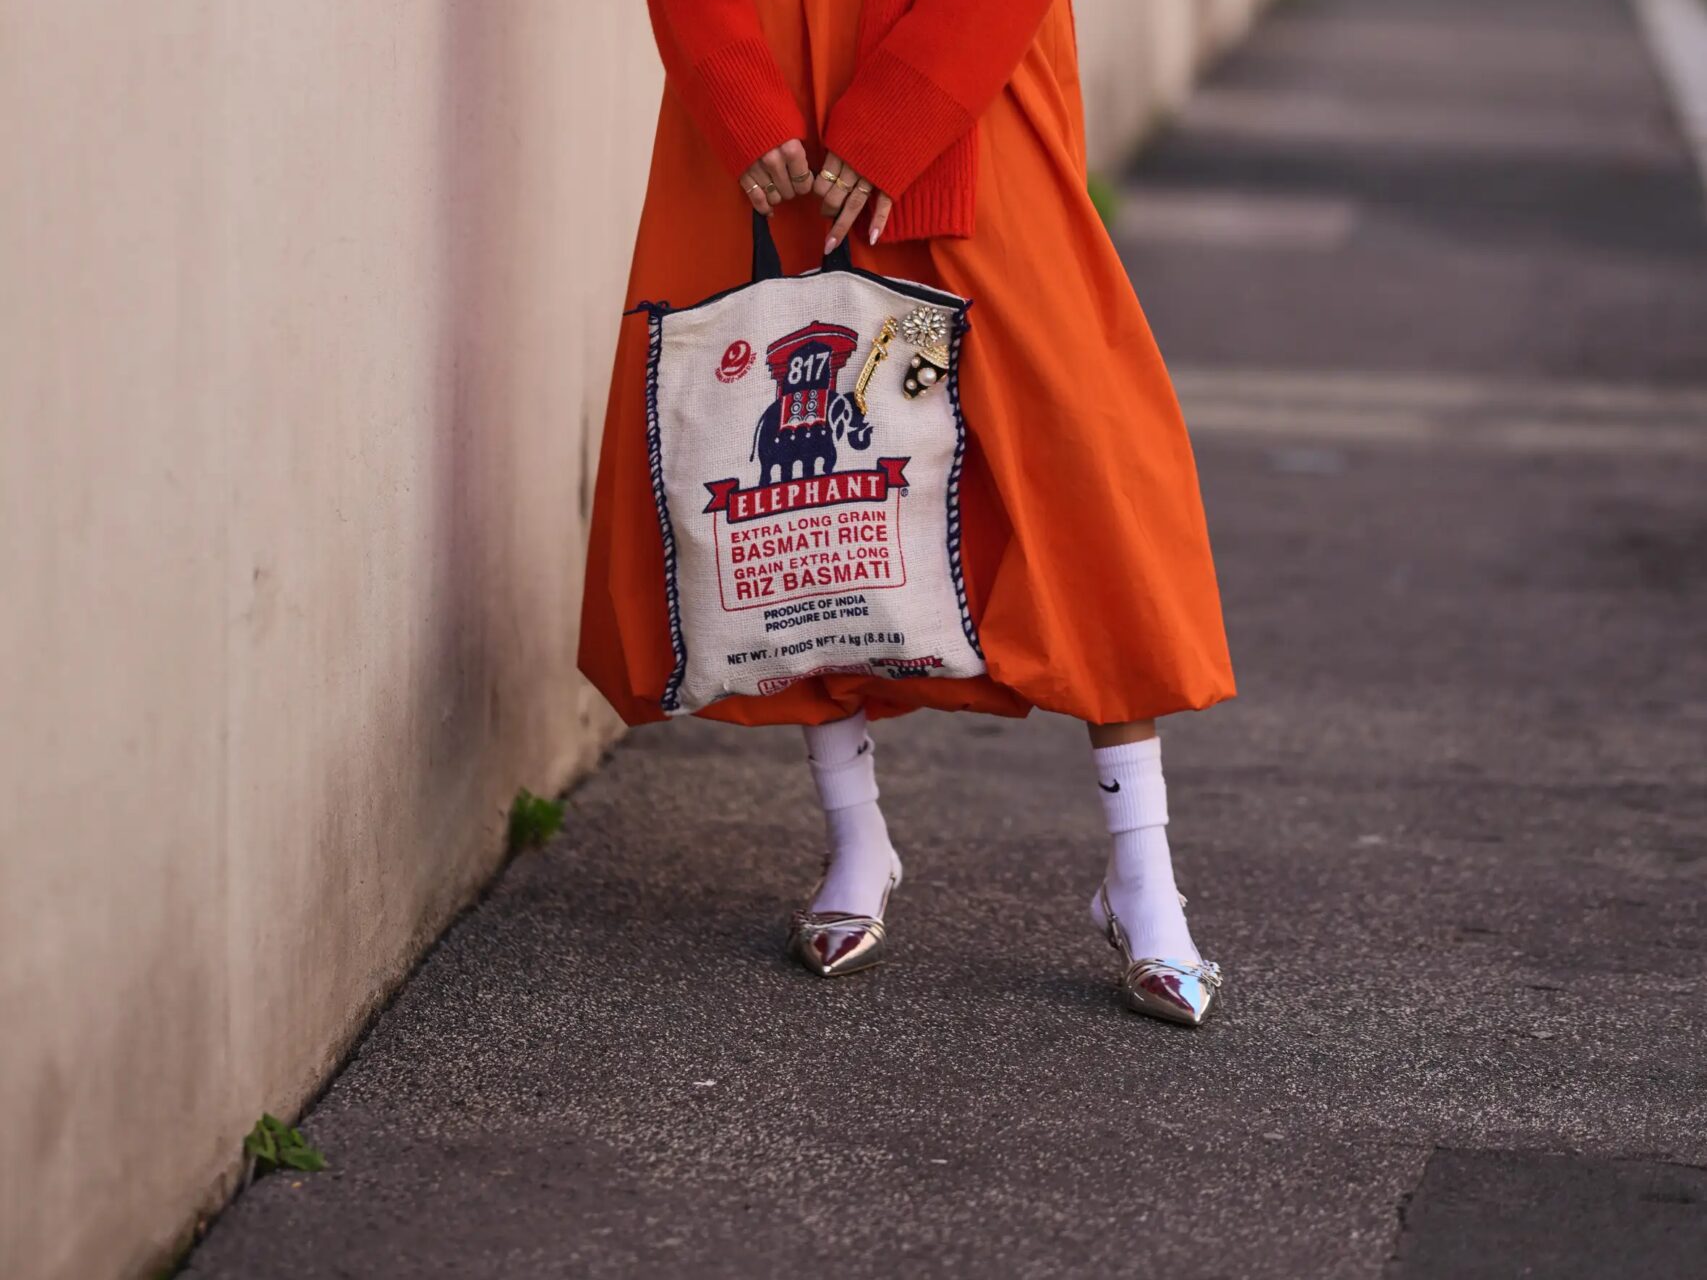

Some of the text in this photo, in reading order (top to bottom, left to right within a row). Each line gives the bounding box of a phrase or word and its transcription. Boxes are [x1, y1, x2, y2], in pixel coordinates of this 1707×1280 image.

[788, 351, 829, 384] 817
[737, 475, 880, 518] ELEPHANT
[731, 511, 886, 544] EXTRA LONG GRAIN
[731, 525, 888, 564] BASMATI RICE
[734, 547, 889, 580] GRAIN EXTRA LONG
[736, 560, 890, 600] RIZ BASMATI
[764, 594, 866, 620] PRODUCE OF INDIA
[765, 612, 820, 632] PRODUIRE
[823, 610, 837, 620] DE
[727, 652, 748, 665] NET
[750, 649, 772, 661] WT.
[781, 640, 813, 657] POIDS
[839, 634, 846, 644] 4
[849, 634, 861, 646] kg
[864, 632, 885, 646] (8.8
[888, 632, 905, 646] LB)
